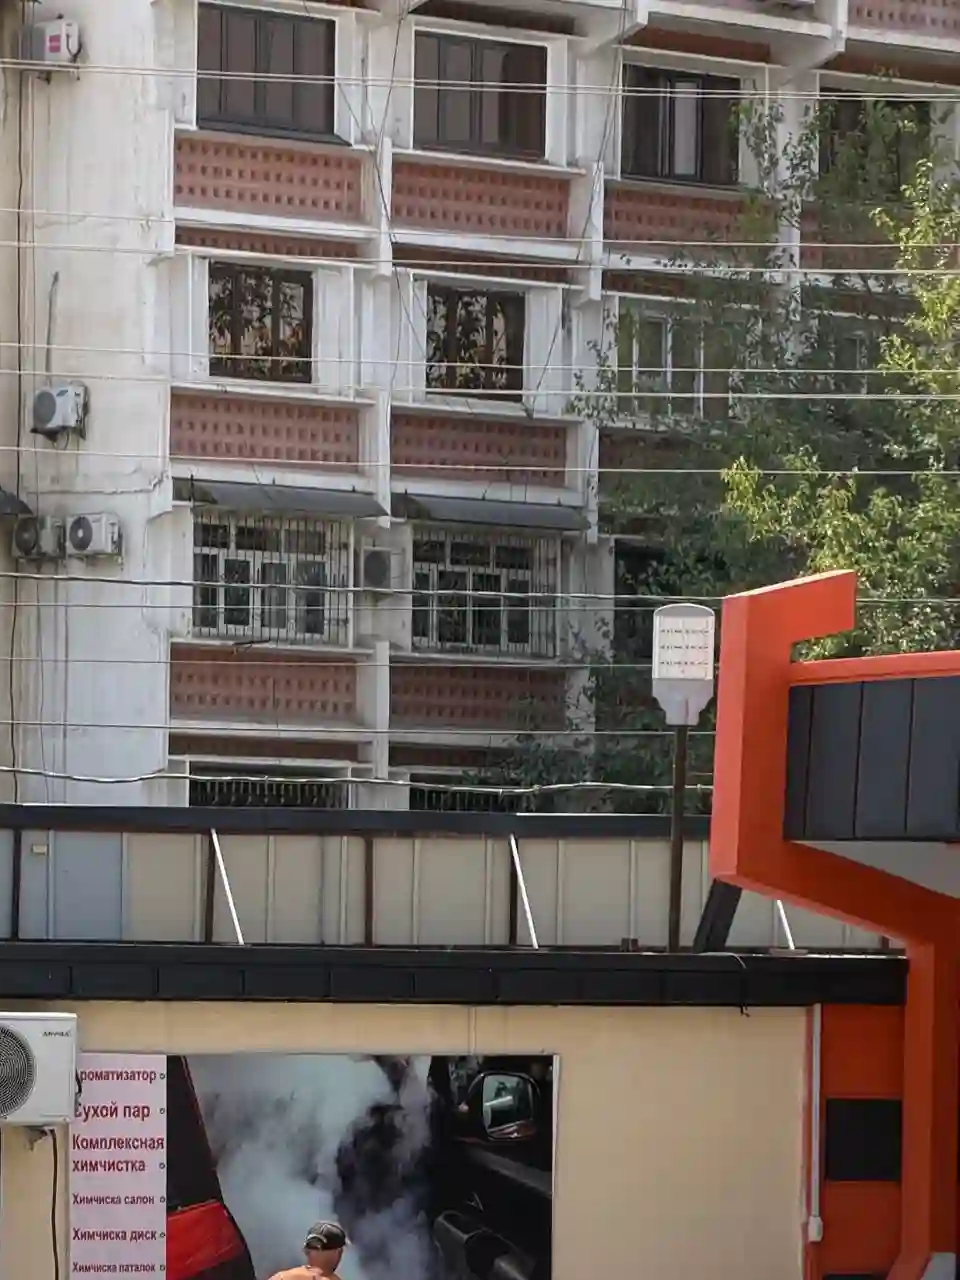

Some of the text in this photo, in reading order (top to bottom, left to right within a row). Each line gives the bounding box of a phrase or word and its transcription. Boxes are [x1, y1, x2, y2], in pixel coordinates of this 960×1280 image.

[78, 1069, 157, 1084] роматизатор
[123, 1105, 151, 1121] пар
[72, 1134, 165, 1150] Комплексная
[72, 1160, 146, 1172] химчистка
[124, 1196, 155, 1205] салон
[129, 1230, 157, 1242] диск
